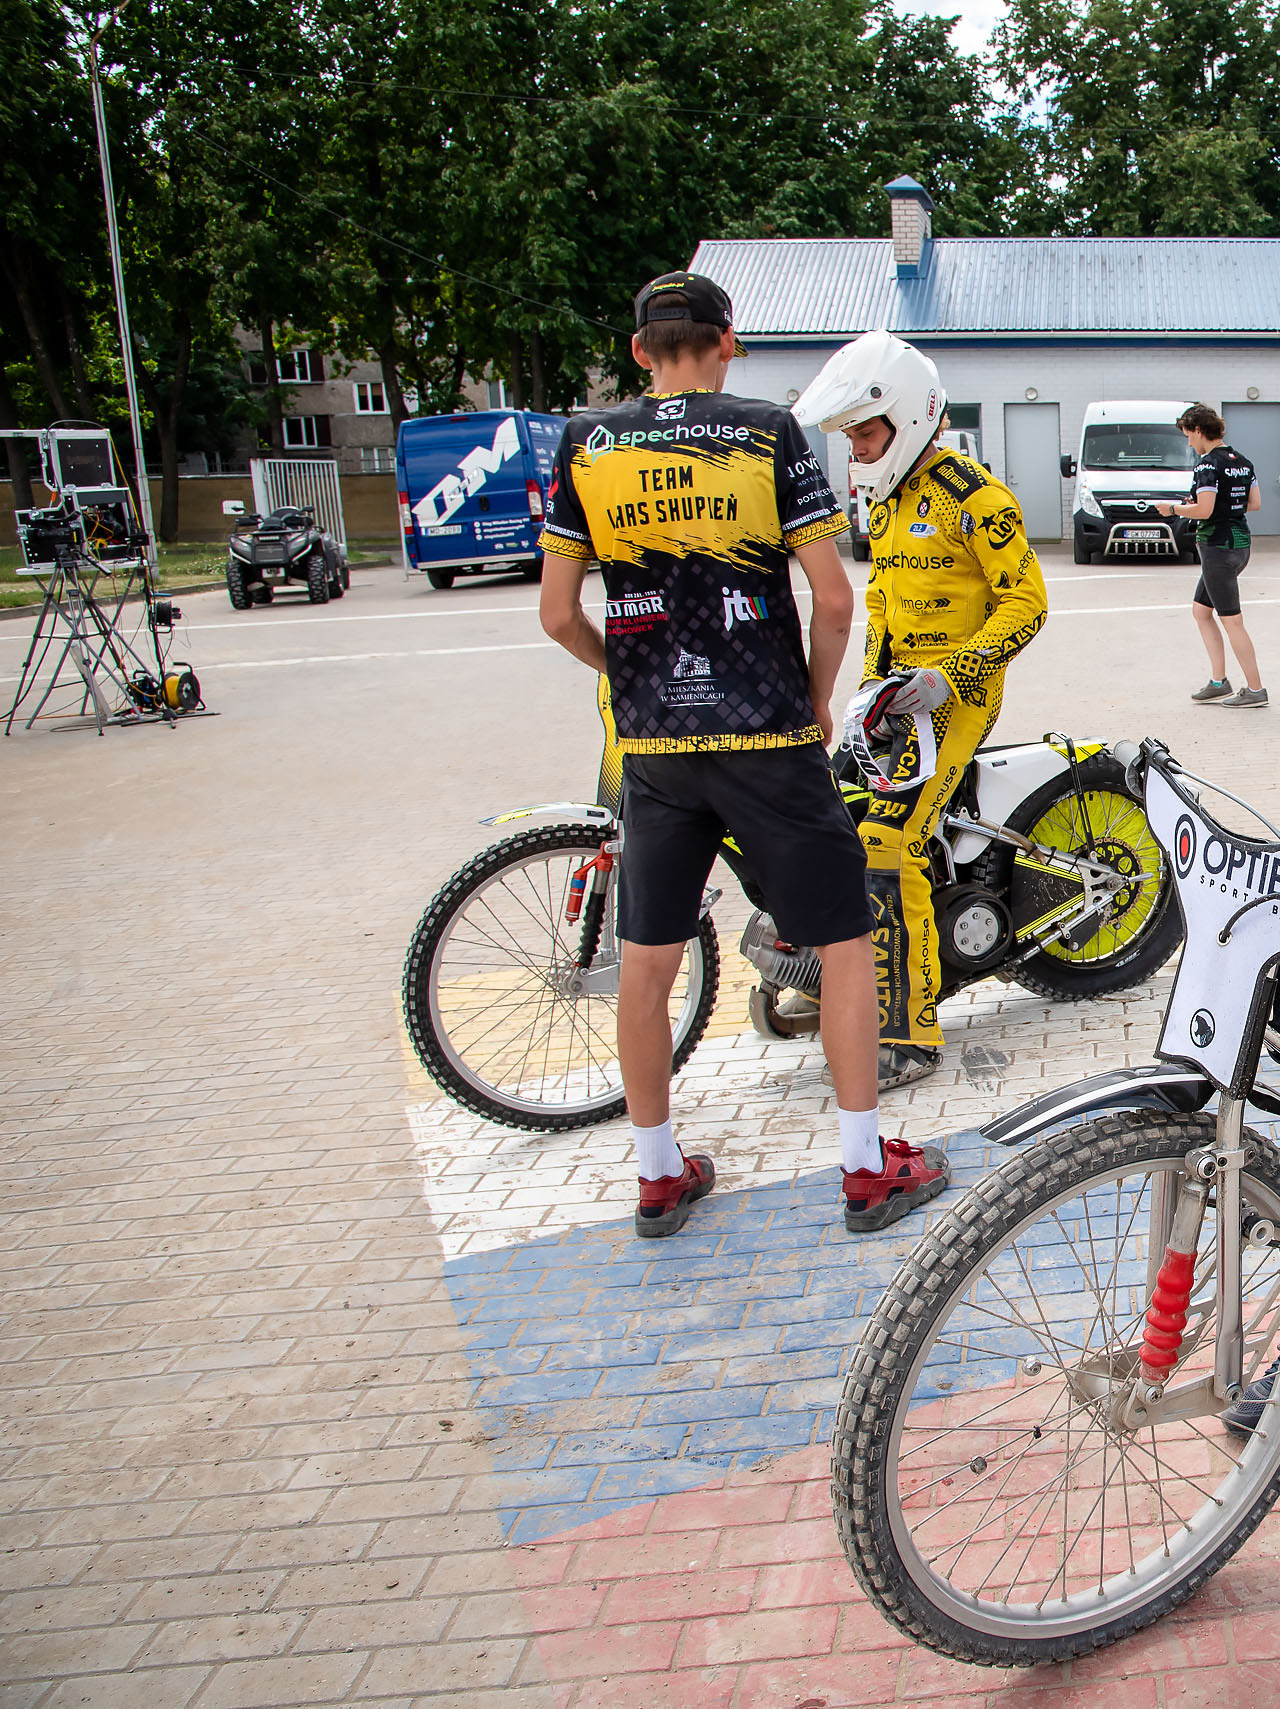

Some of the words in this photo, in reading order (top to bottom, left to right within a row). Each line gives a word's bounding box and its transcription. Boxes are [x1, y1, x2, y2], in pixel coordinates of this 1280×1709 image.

[928, 394, 936, 417] BELL
[639, 465, 694, 492] TEAM
[1200, 875, 1259, 908] SPORT
